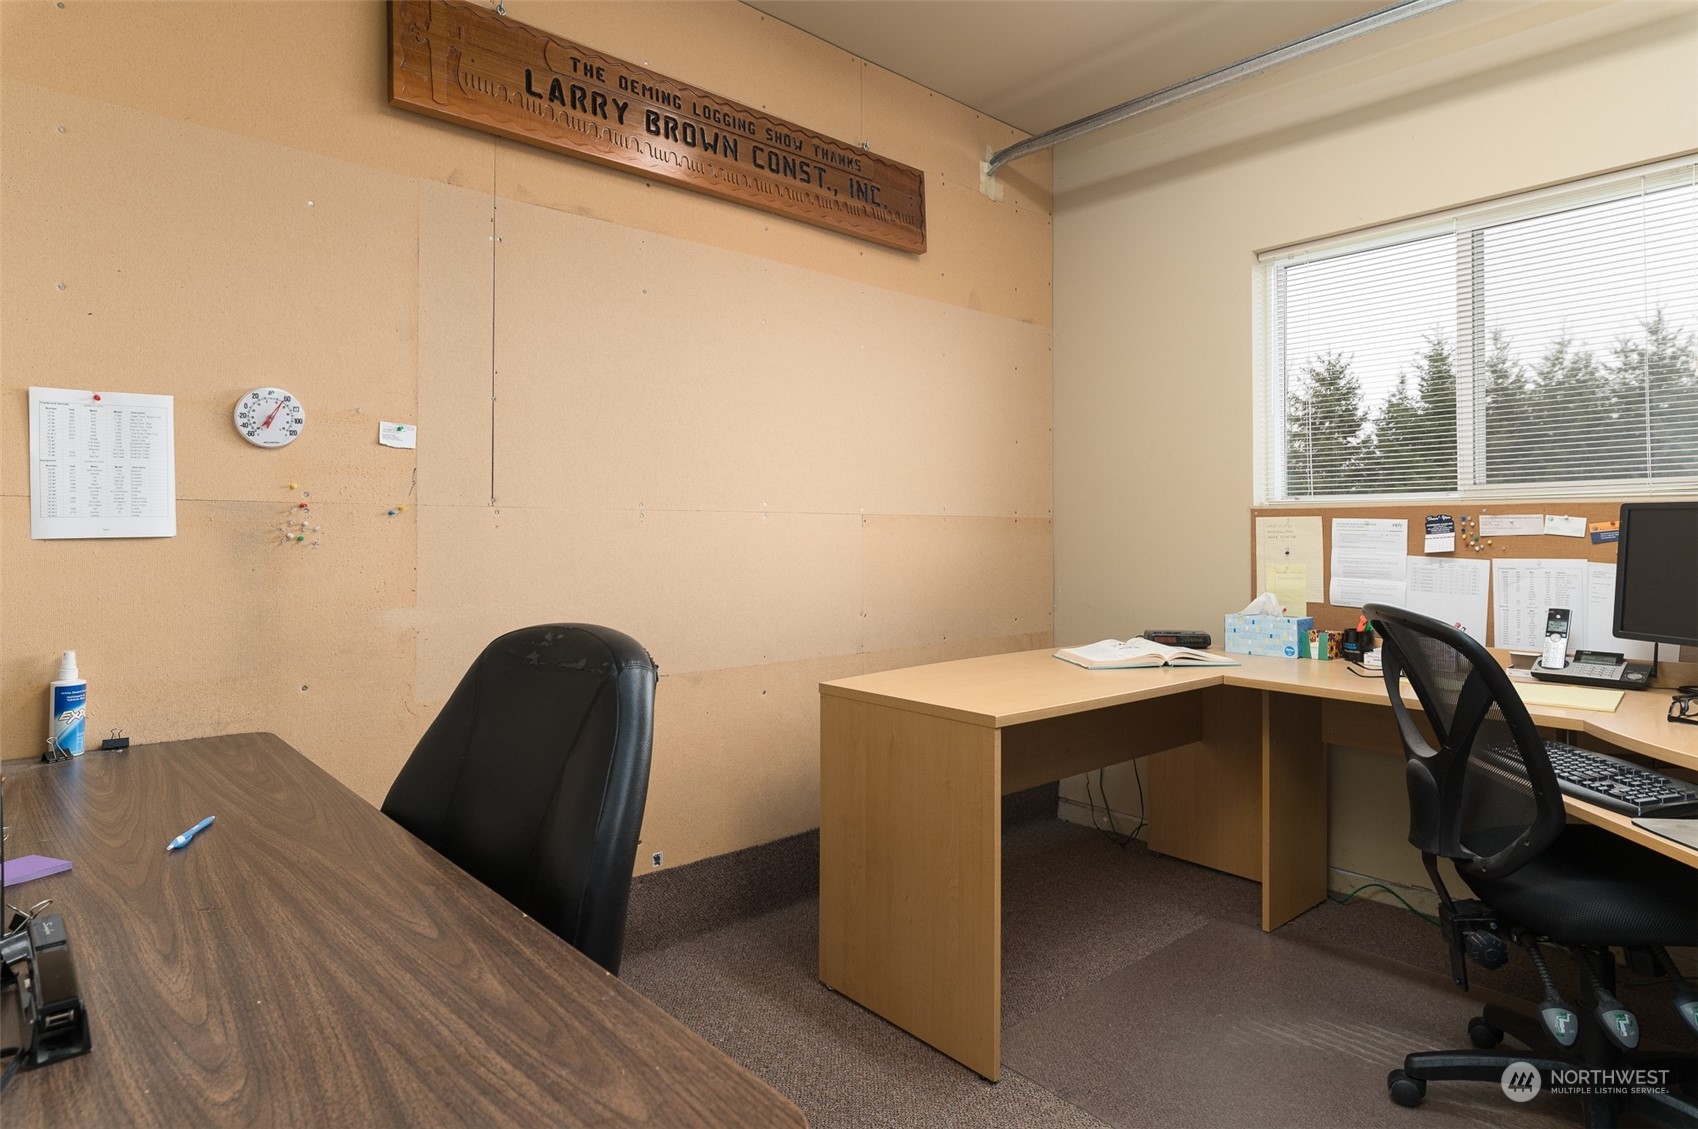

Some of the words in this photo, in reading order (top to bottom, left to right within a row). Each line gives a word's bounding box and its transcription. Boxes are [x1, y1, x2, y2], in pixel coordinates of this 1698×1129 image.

[524, 68, 630, 126] LARRY
[645, 109, 740, 160] BROWN
[848, 179, 889, 209] INC.
[570, 56, 607, 84] THE
[618, 74, 683, 110] DEMING
[692, 100, 757, 136] LOGGING
[765, 126, 805, 152] SHOW
[813, 142, 863, 172] THANKS
